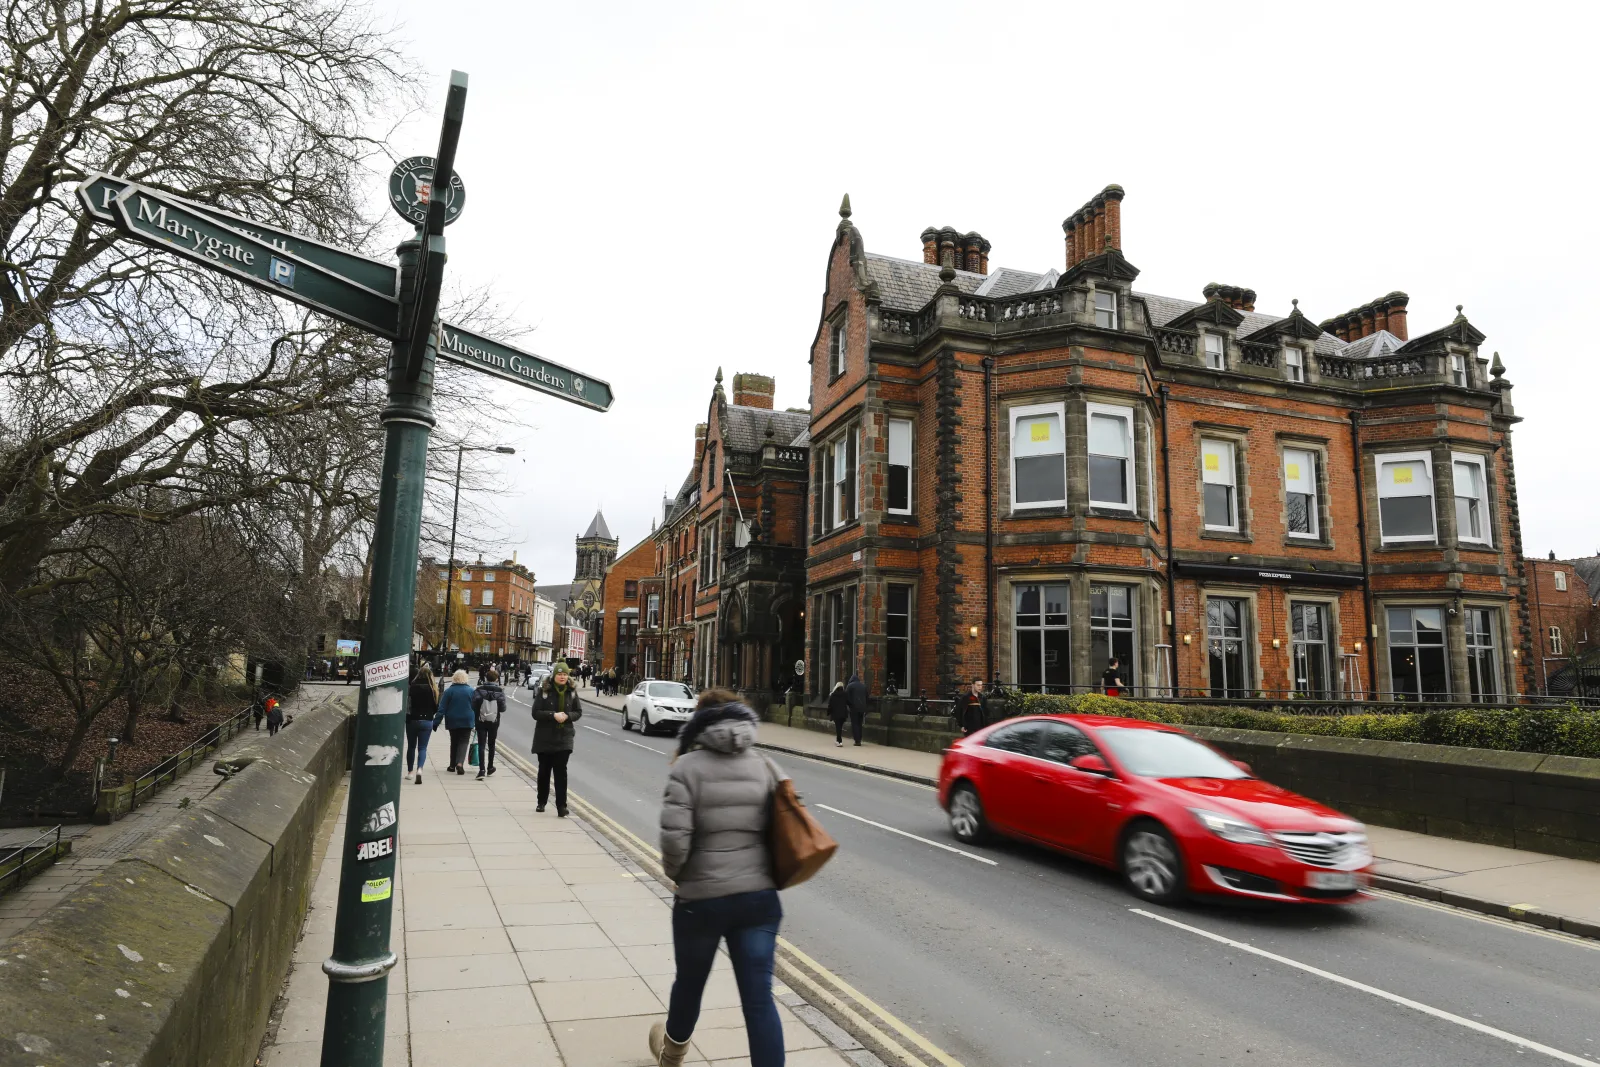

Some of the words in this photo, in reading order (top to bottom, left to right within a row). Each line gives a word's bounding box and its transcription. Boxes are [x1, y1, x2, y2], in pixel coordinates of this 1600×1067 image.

[393, 159, 417, 178] THE
[420, 156, 436, 167] CI
[450, 175, 465, 191] OF
[406, 206, 424, 220] YO
[136, 195, 256, 266] Marygate
[274, 260, 292, 281] P
[440, 330, 507, 369] Museum
[508, 355, 566, 389] Gardens
[366, 664, 390, 676] YORK
[392, 660, 408, 670] CITY
[368, 672, 397, 682] FOOTBALL
[356, 836, 393, 861] ABEL
